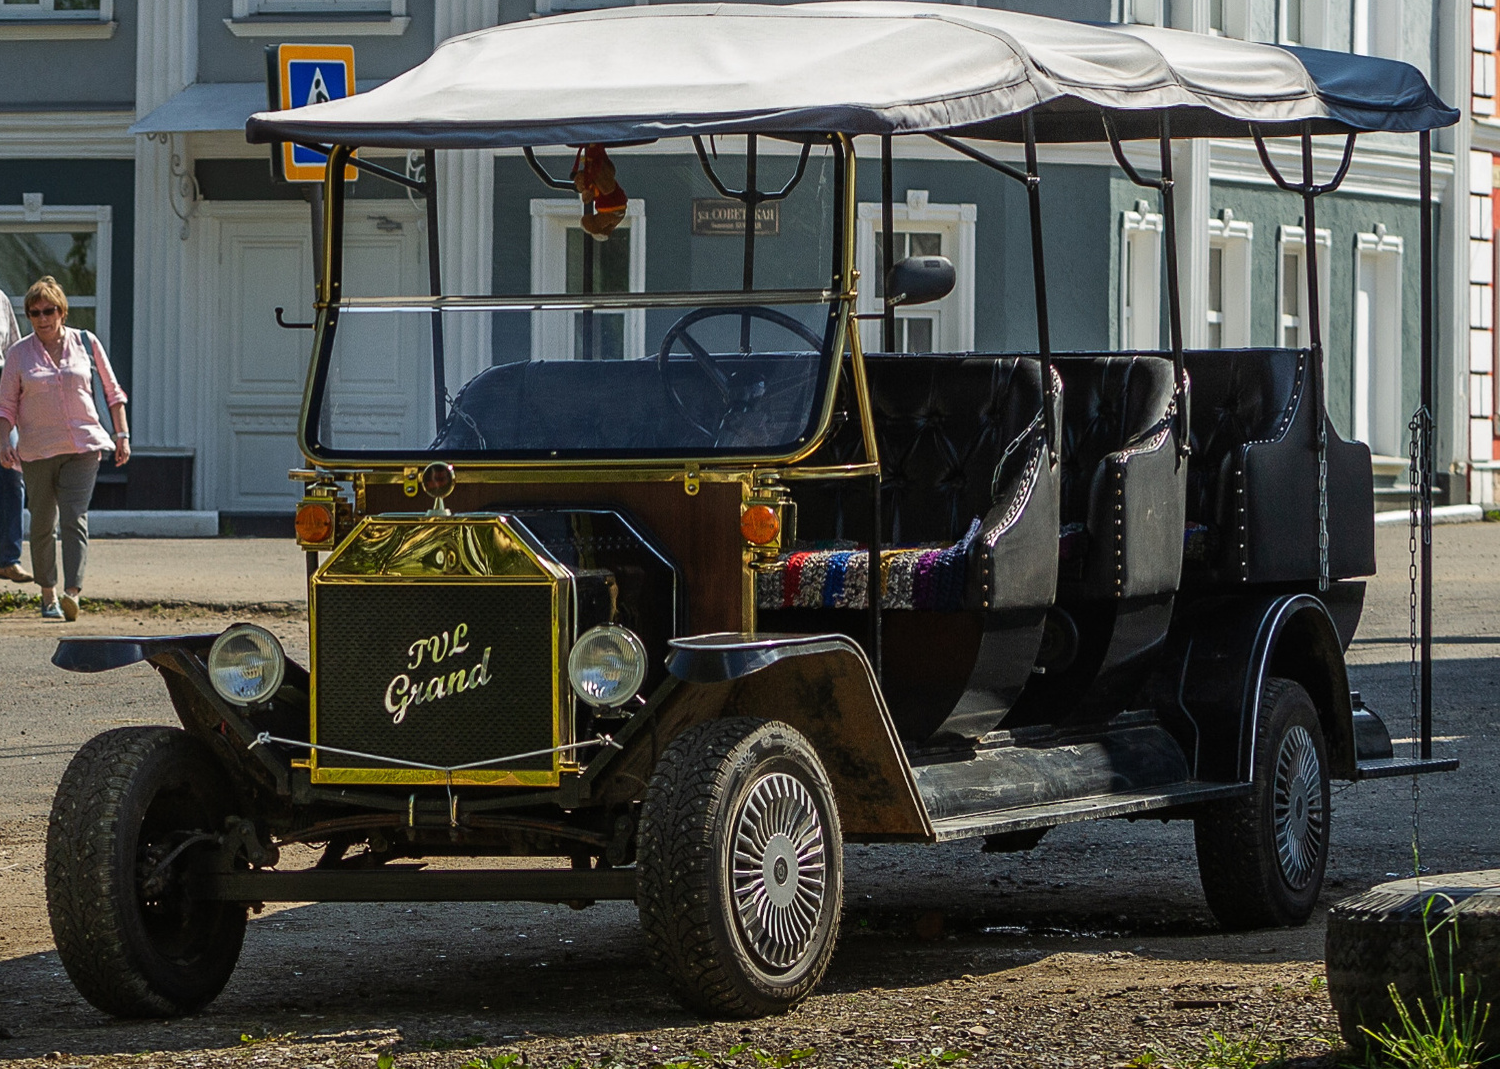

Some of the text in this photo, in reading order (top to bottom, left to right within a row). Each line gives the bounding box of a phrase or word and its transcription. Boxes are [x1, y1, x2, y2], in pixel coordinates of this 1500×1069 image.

[711, 207, 774, 221] СОВЕТКАЯ
[407, 623, 470, 669] TVL
[385, 646, 492, 724] Grand
